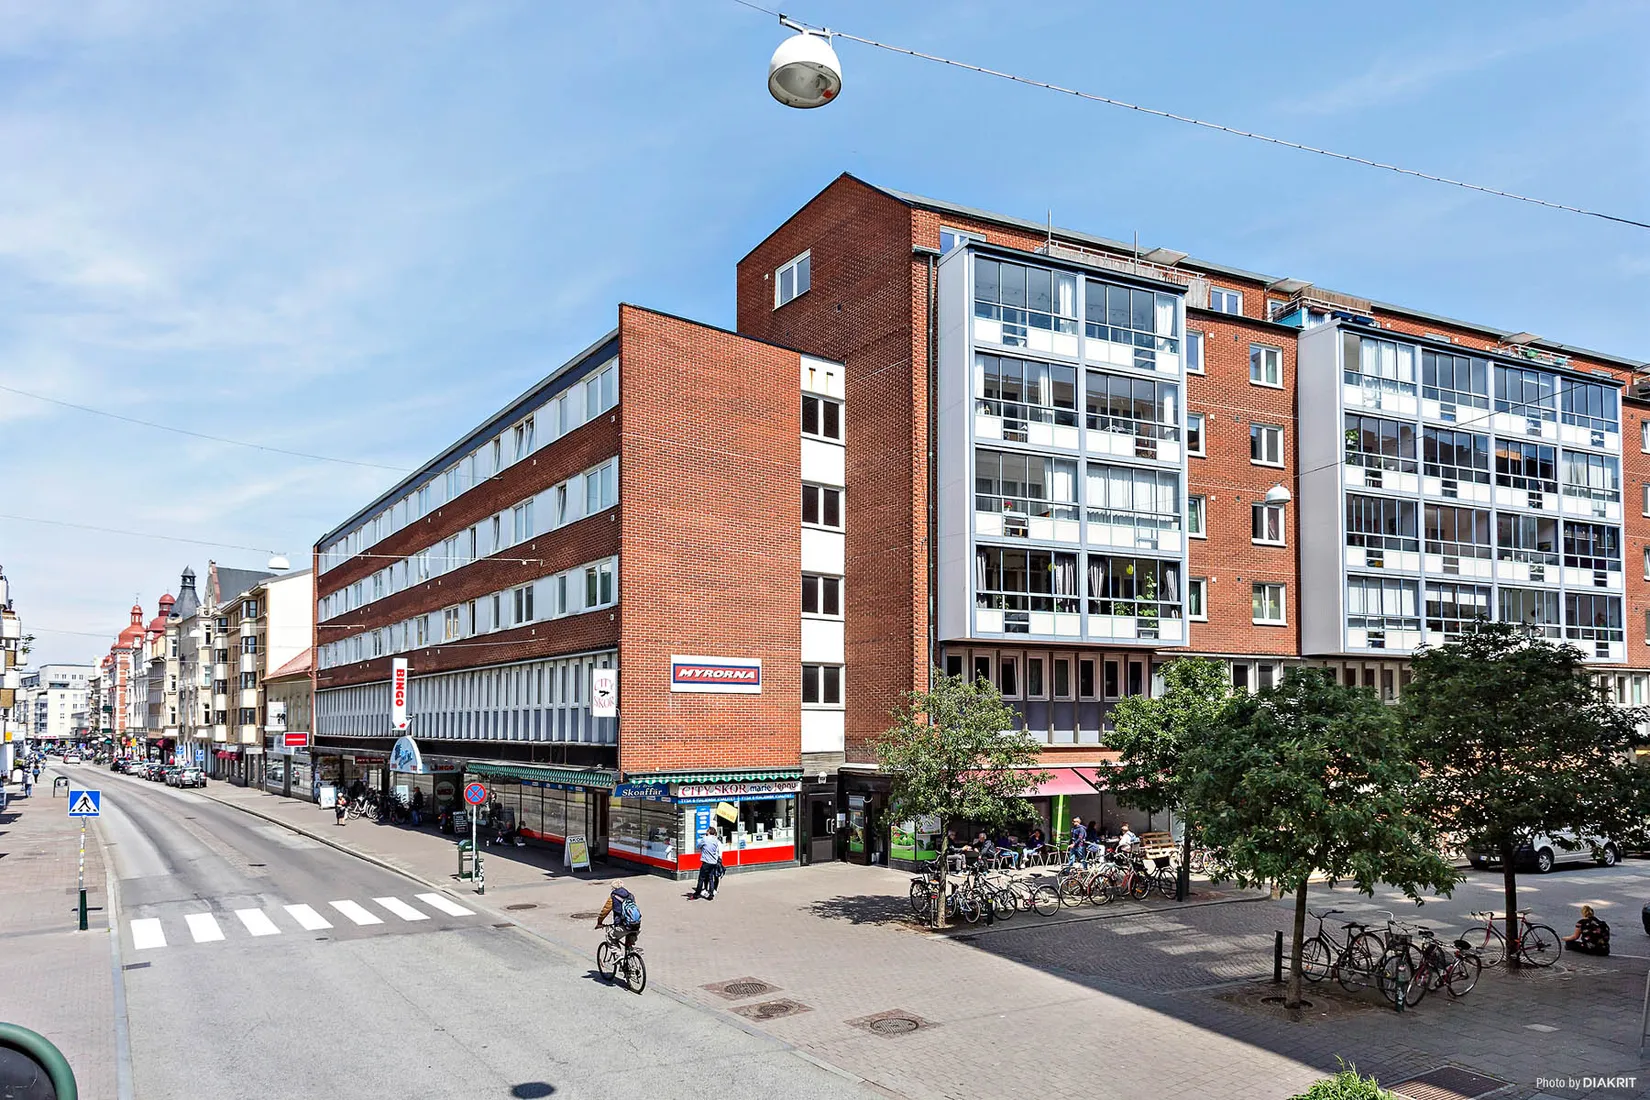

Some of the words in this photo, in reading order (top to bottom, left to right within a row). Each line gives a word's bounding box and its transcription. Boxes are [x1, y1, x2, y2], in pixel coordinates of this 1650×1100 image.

[678, 668, 755, 679] MYRORNA
[395, 668, 405, 707] BINGO
[594, 696, 615, 708] SKOR
[681, 785, 712, 796] CITY
[714, 783, 747, 795] SKOR
[749, 783, 771, 792] marie
